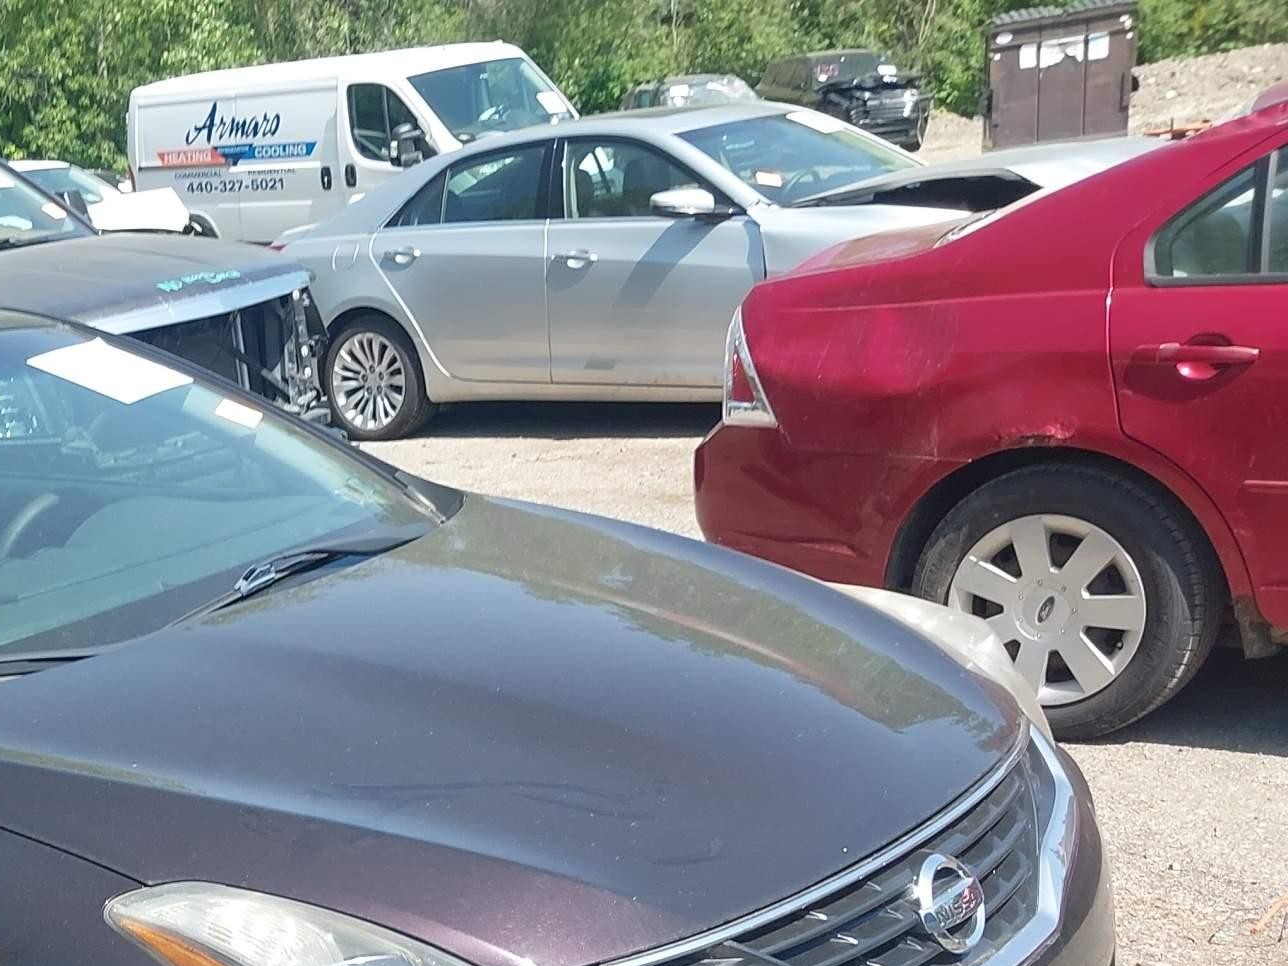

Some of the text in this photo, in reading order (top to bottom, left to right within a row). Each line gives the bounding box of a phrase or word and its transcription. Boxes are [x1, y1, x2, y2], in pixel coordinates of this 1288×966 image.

[164, 151, 211, 164] HEATING
[254, 144, 306, 158] COOLING
[186, 177, 285, 194] 440-327-5021
